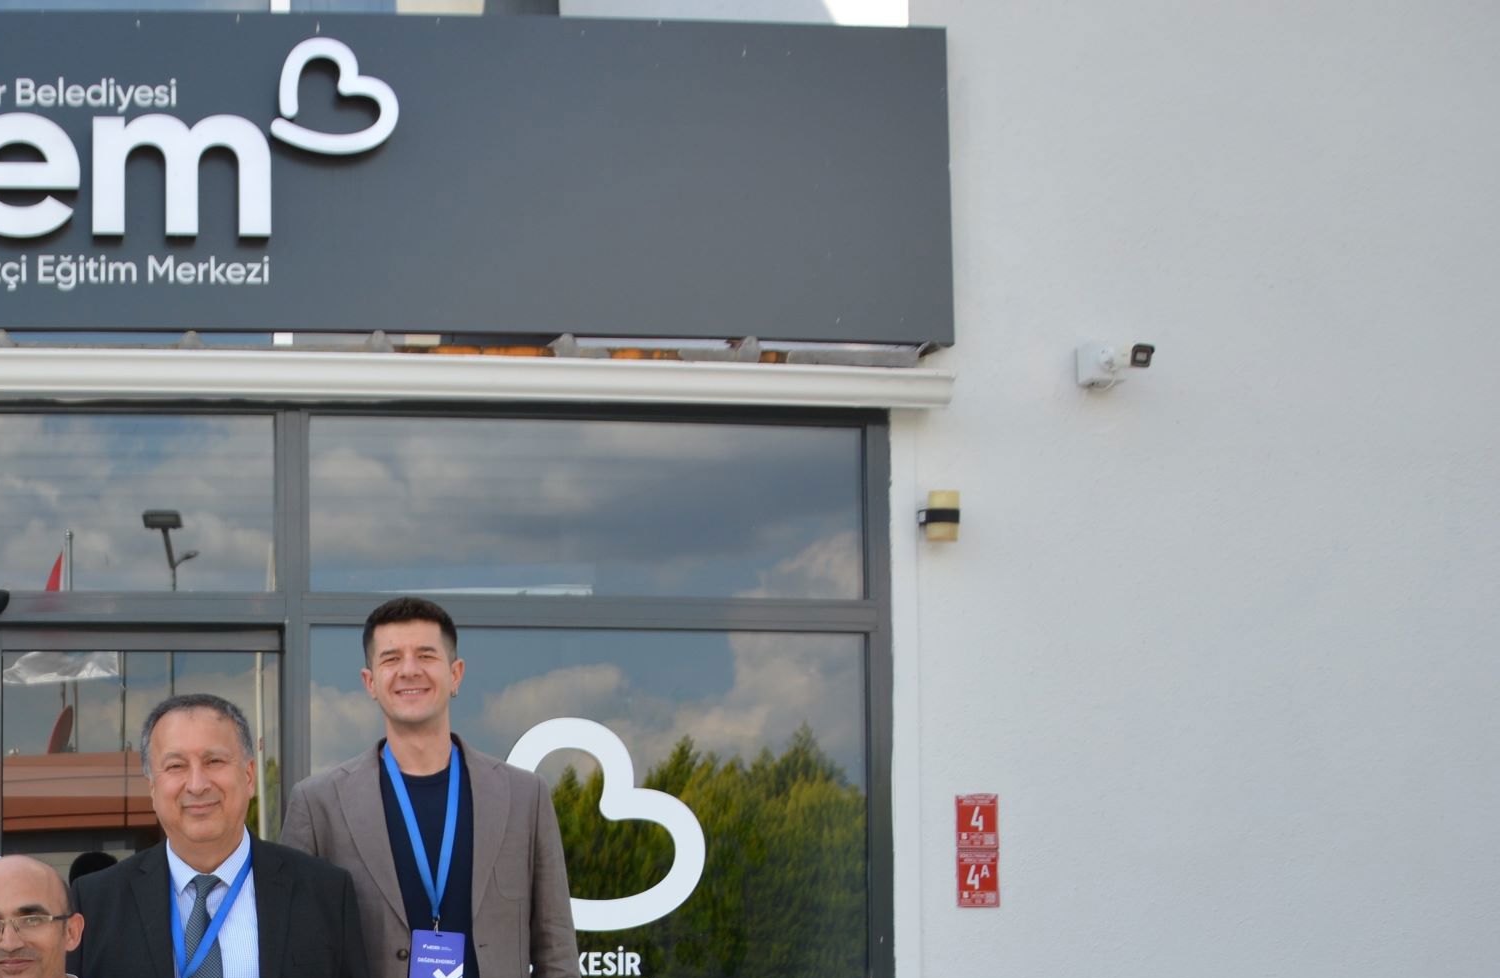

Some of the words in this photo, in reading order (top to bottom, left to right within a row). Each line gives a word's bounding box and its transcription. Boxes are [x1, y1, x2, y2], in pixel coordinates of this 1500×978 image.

[15, 76, 177, 114] Belediyesi
[37, 254, 138, 289] Eğitim
[148, 255, 270, 284] Merkezi
[970, 805, 984, 832] 4
